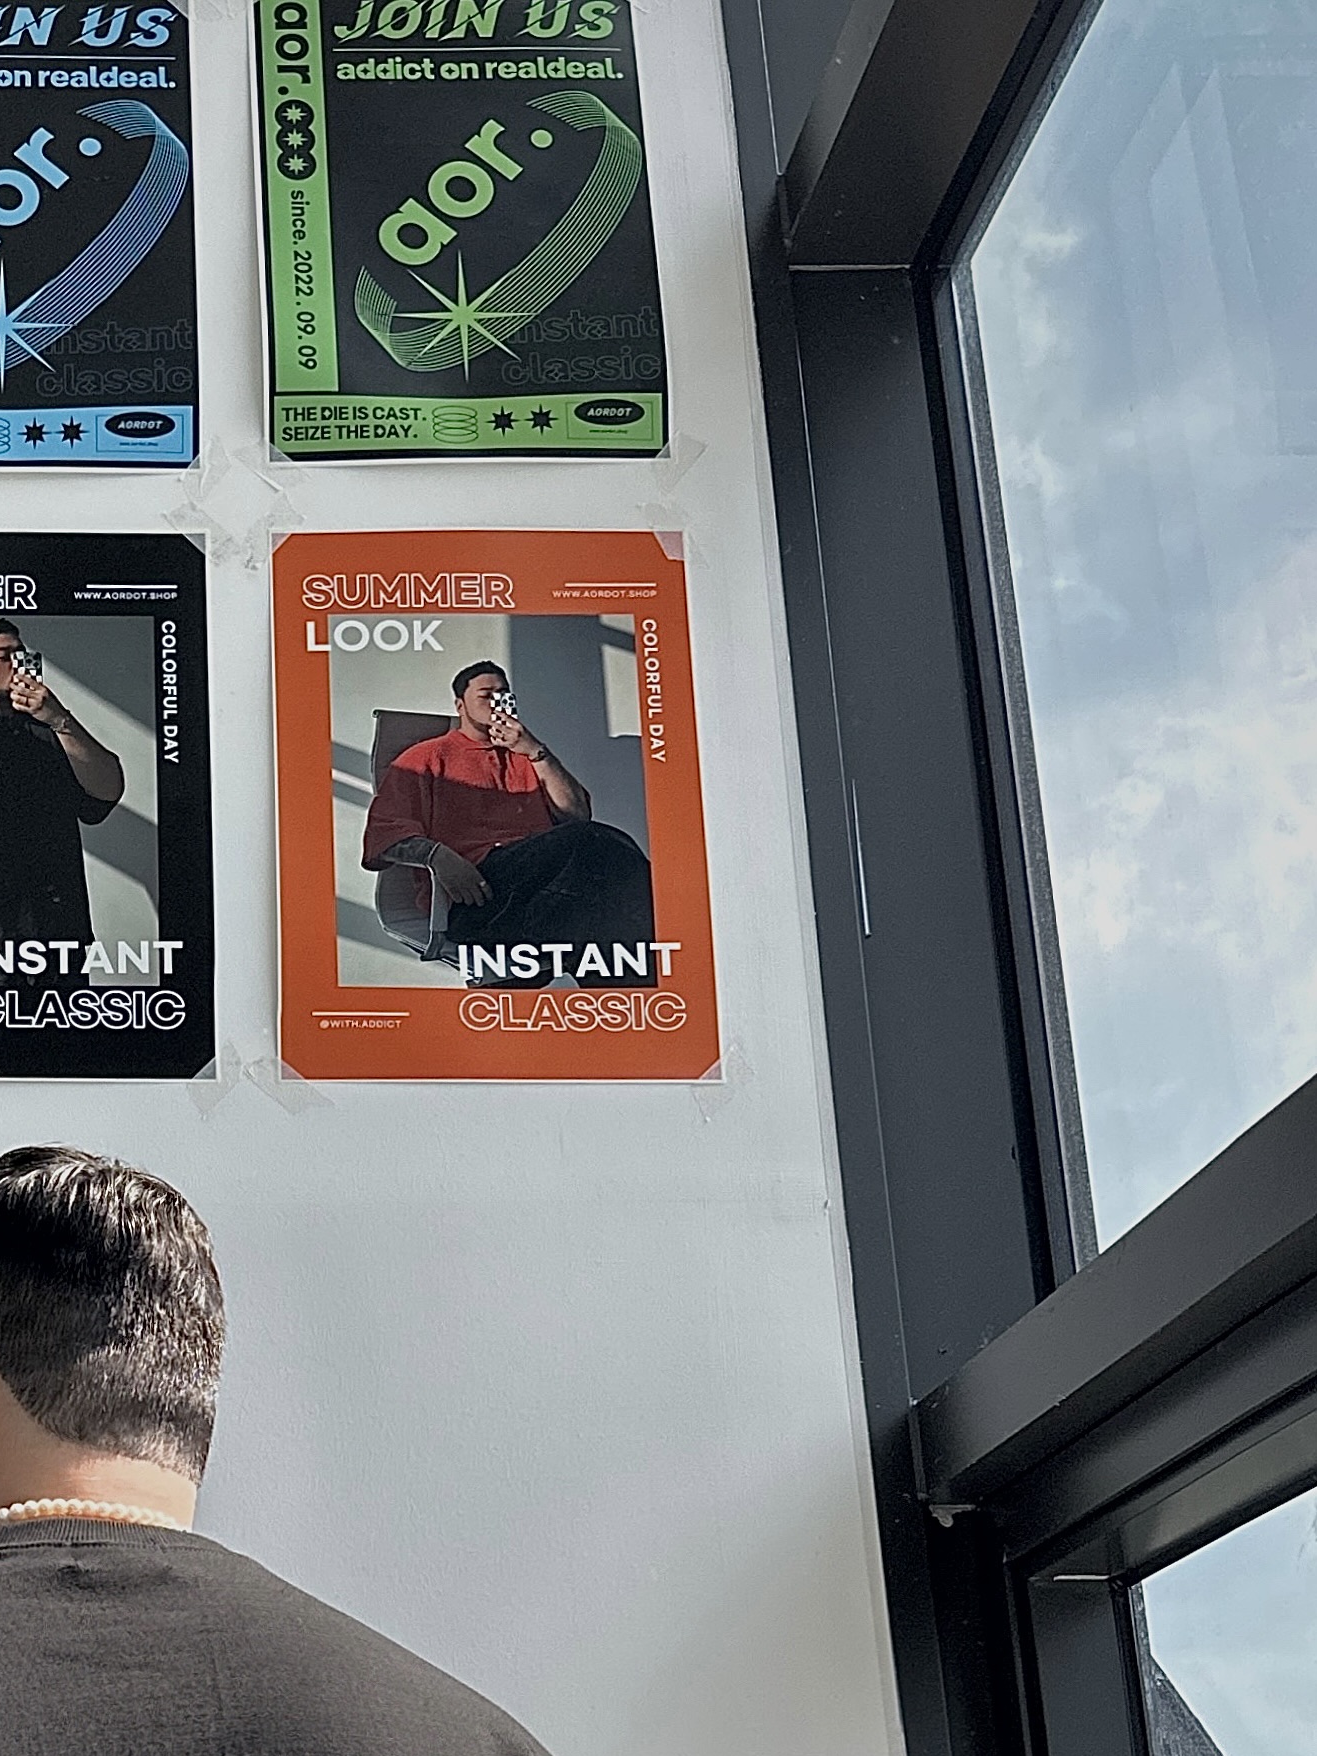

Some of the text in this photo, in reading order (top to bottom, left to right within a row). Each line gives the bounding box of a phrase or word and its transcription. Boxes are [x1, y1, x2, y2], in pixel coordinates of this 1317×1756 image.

[81, 4, 178, 48] US
[334, 0, 620, 42] JOIN US
[273, 1, 310, 97] aor.
[38, 65, 176, 89] realdeal.
[336, 57, 624, 80] addict on realdeal.
[378, 119, 555, 266] aor.
[290, 189, 309, 246] since.
[44, 319, 193, 354] nstant
[507, 306, 659, 344] nstant
[36, 358, 193, 397] classic
[501, 345, 661, 386] classic
[282, 406, 426, 422] THE DIE IS CAST.
[282, 424, 418, 441] SEIZE THE DAY.
[74, 592, 178, 600] WWW.AORDOT.SHOP
[302, 573, 515, 609] SUMMER
[552, 590, 657, 598] WWW.AORDOT.SHOP
[306, 620, 444, 652] LOOK
[161, 620, 179, 763] COLORFUL DAY
[641, 618, 668, 763] COLORFUL DAY
[458, 942, 681, 978] INSTANT
[459, 992, 686, 1032] CLASSIC
